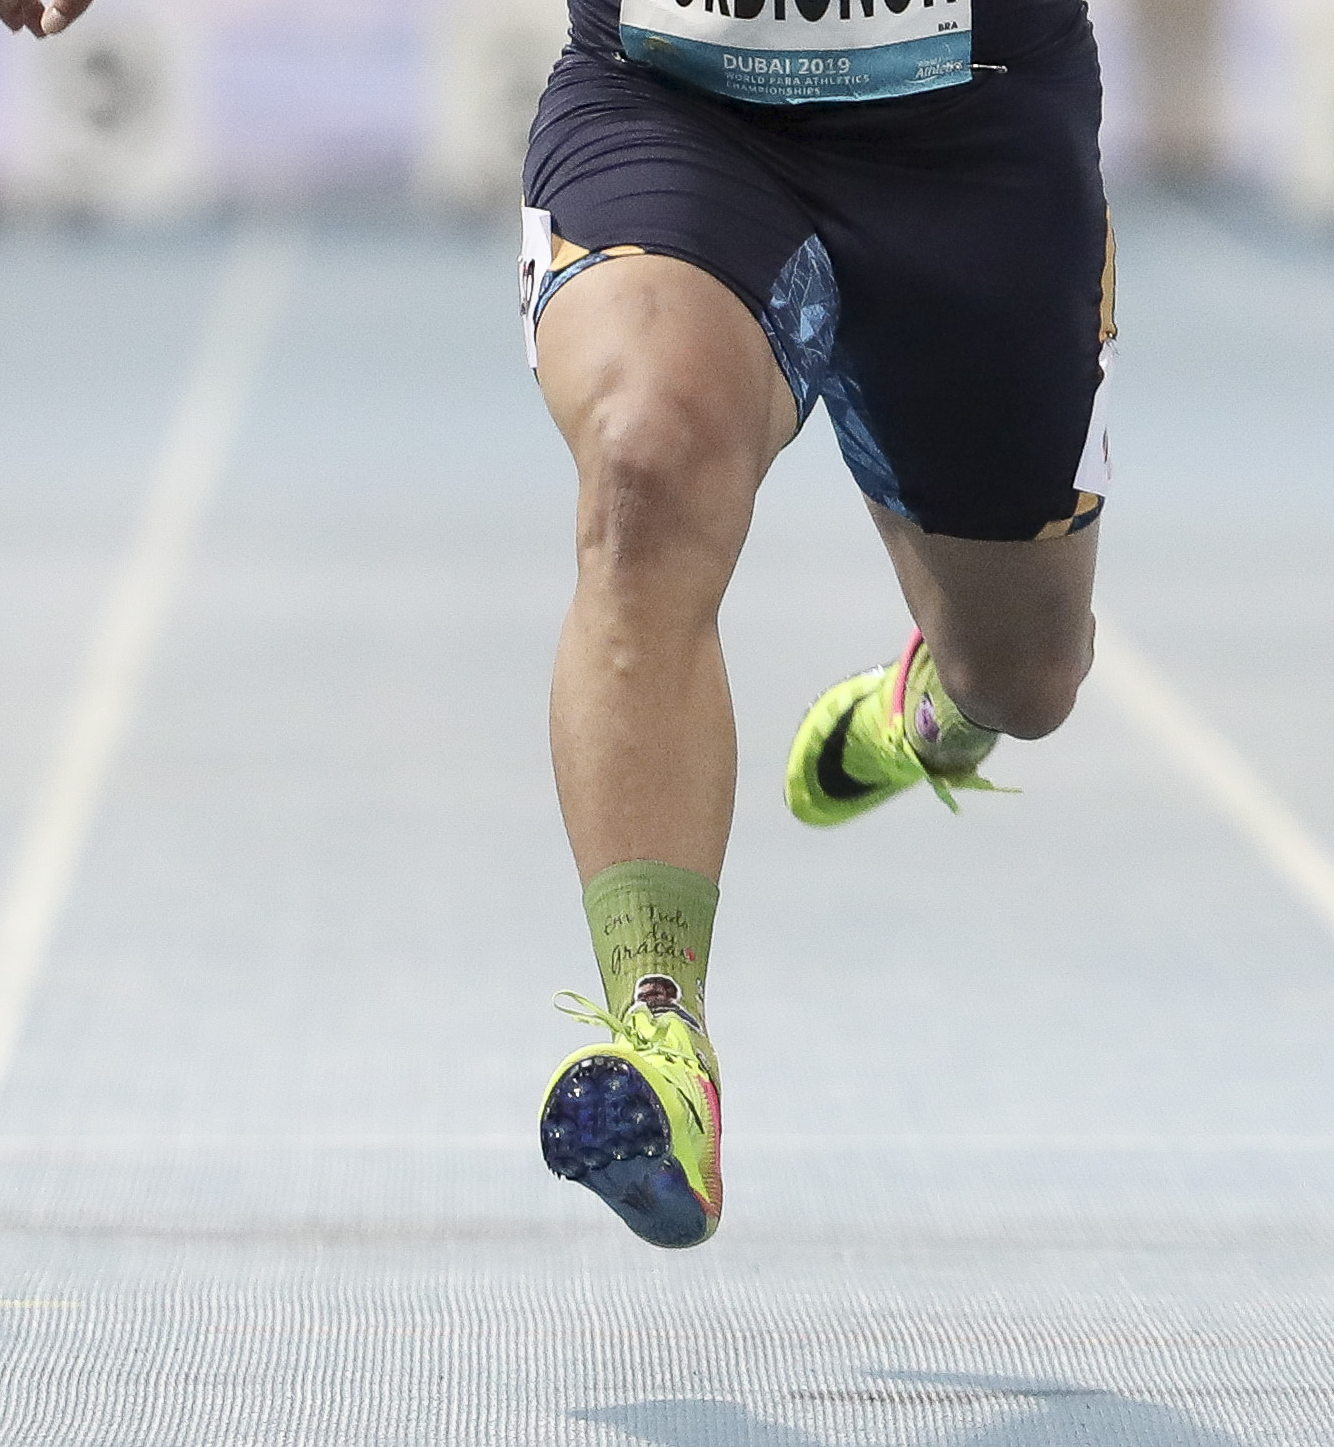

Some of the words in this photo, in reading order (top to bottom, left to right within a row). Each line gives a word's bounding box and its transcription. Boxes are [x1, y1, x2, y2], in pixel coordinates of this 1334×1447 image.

[938, 21, 958, 32] BRA
[723, 54, 791, 75] DUBAI
[798, 57, 852, 75] 2019
[725, 72, 765, 85] WORLD
[769, 75, 800, 86] PARA
[804, 74, 871, 86] ATHLETICS
[725, 82, 821, 96] CHAMPIONSHIPS
